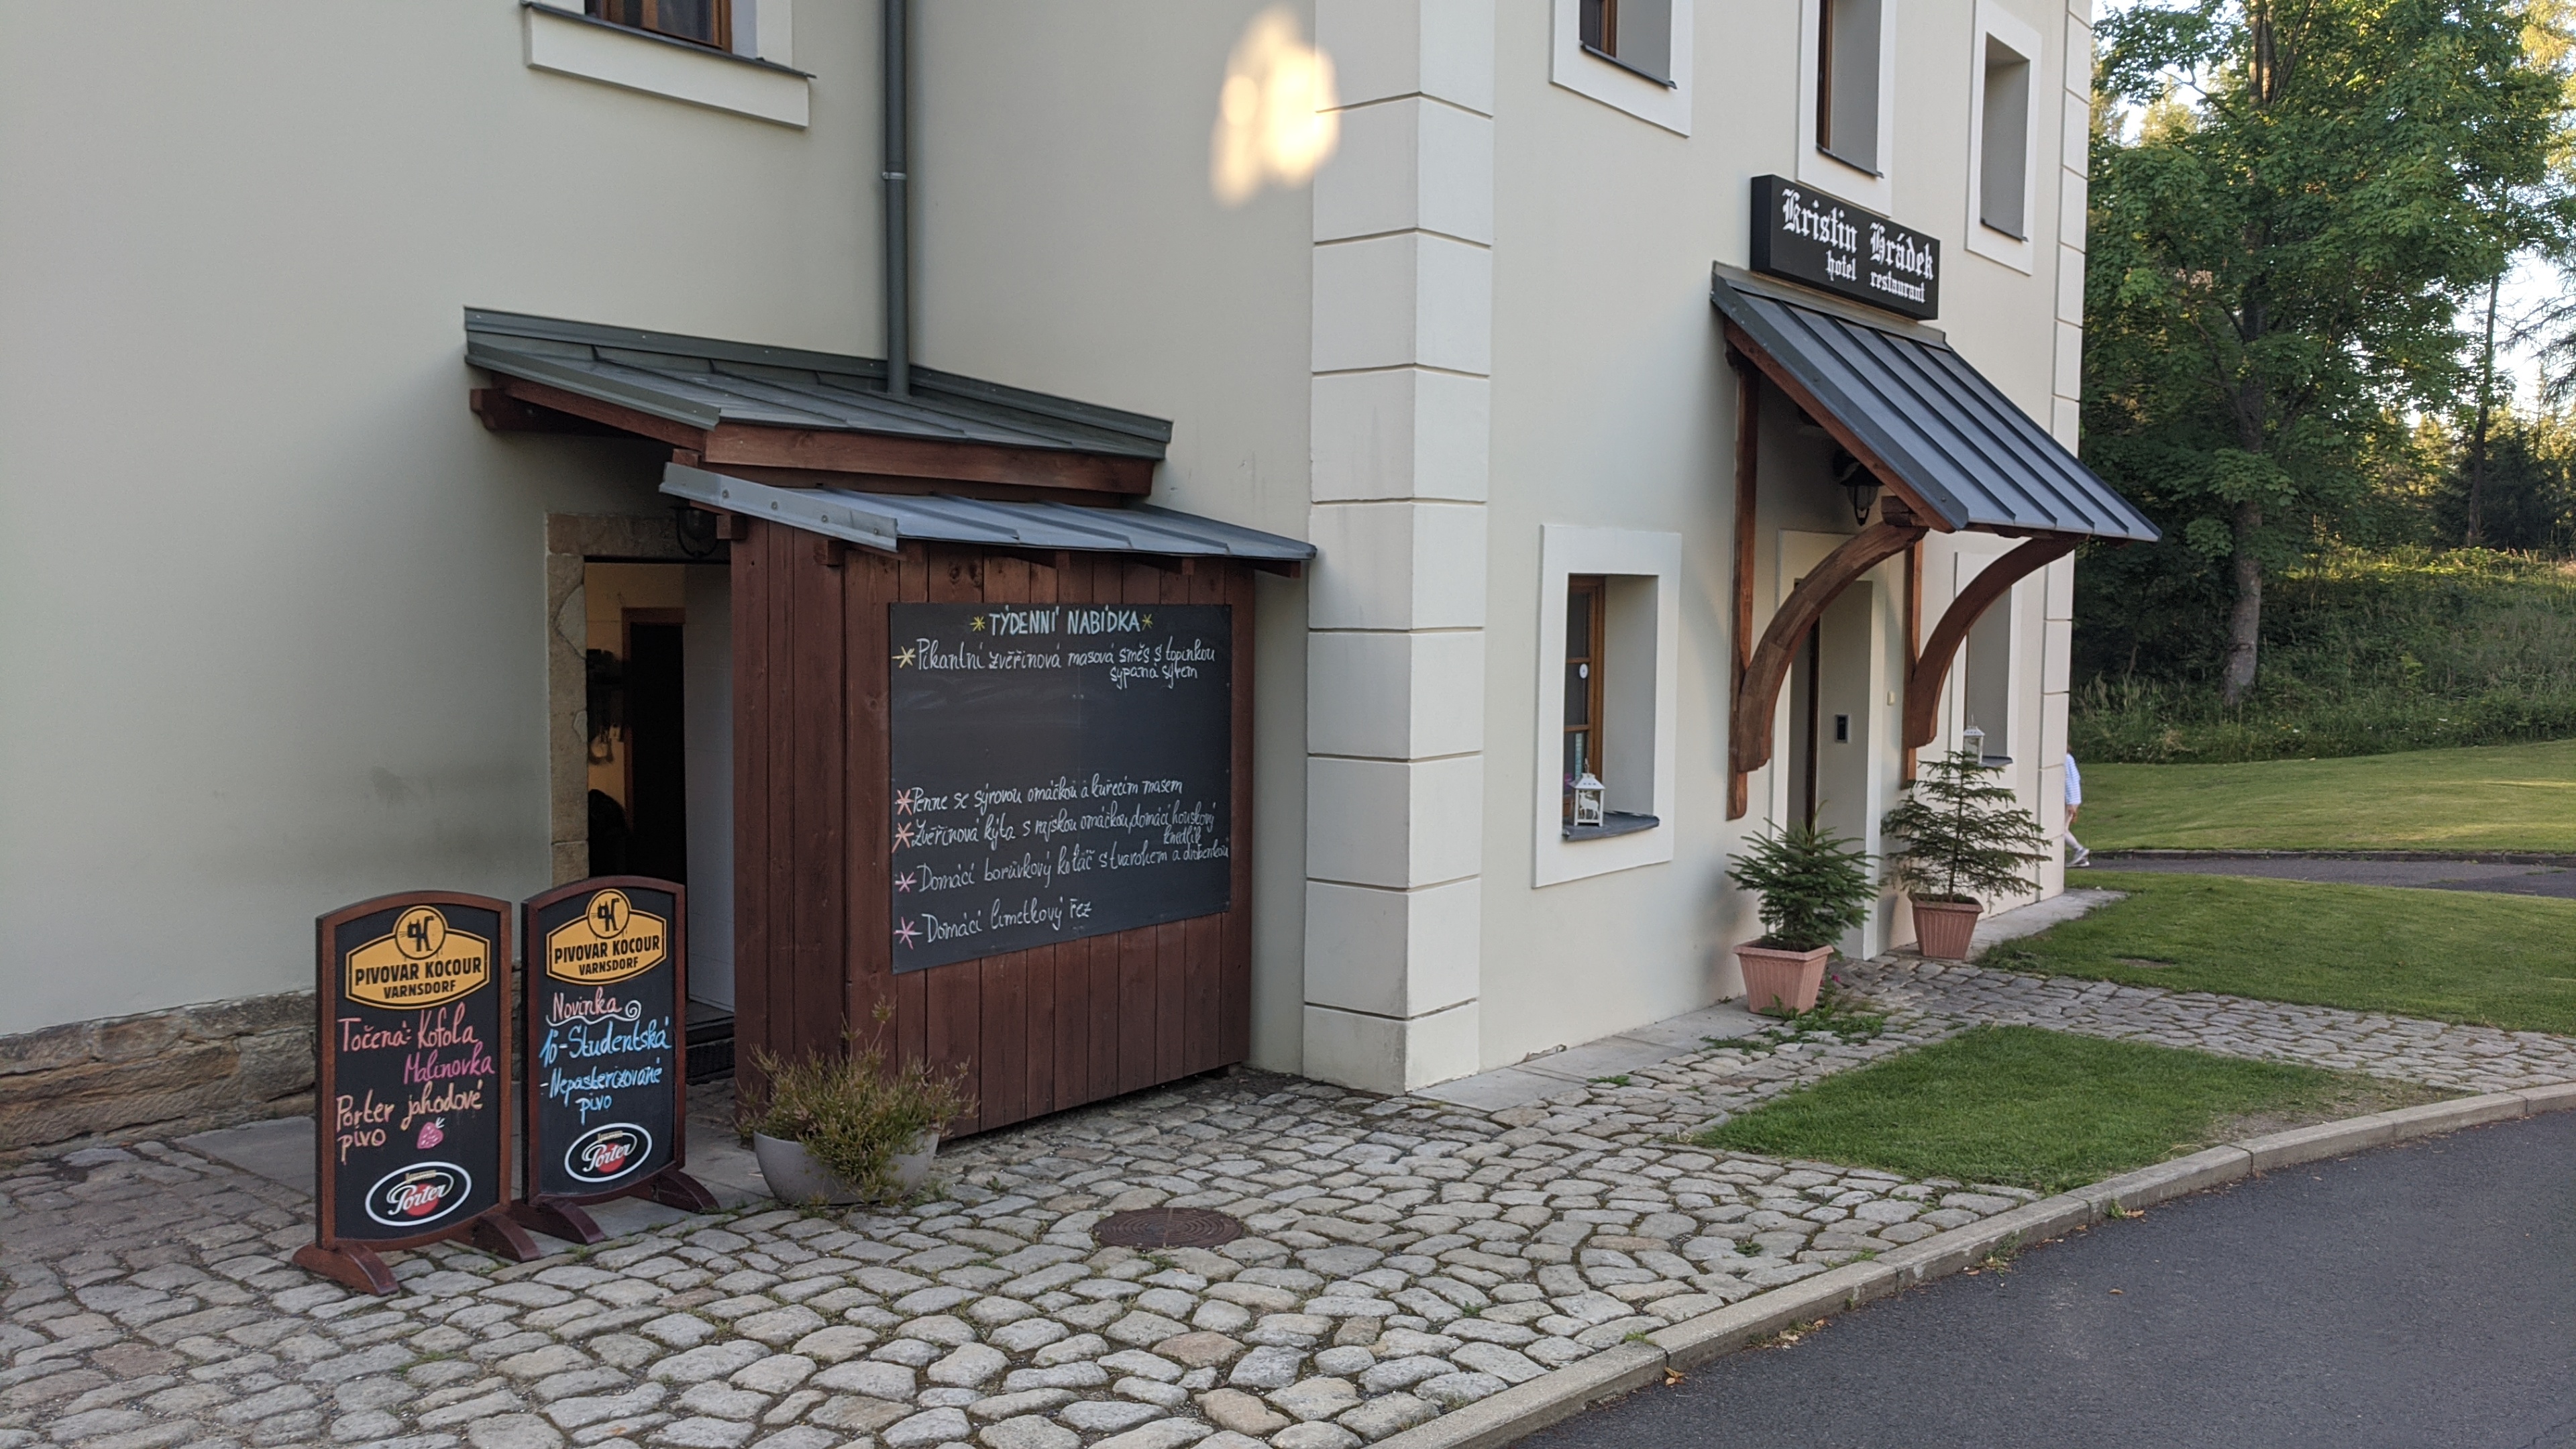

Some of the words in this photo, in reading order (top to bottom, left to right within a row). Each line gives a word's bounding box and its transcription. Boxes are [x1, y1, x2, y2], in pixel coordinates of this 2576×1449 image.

[1782, 189, 1858, 254] Kristin
[1870, 222, 1933, 280] Hrádek
[1825, 250, 1857, 281] hotel
[1870, 270, 1925, 303] restaurant
[989, 606, 1060, 636] TÝDENNÍ
[1067, 604, 1140, 635] NABÍDKA
[916, 637, 985, 670] Pikantní
[989, 642, 1062, 669] zvěřinová
[1067, 643, 1115, 667] masová
[1119, 643, 1150, 663] směs
[1165, 635, 1216, 671] topinkou
[1110, 662, 1159, 690] sypaná
[911, 787, 948, 814] Penne
[953, 792, 969, 810] se
[974, 783, 1022, 816] sýrovou
[1028, 775, 1078, 802] omáčkou
[1091, 773, 1139, 798] kuřecím
[1142, 778, 1183, 795] masem
[911, 818, 979, 847] Zvěřinová
[984, 812, 1016, 851] kýta
[1022, 820, 1031, 837] s
[1034, 808, 1077, 843] rajskou
[1172, 800, 1216, 833] houskový
[1163, 824, 1201, 845] knedlík
[916, 862, 975, 892] Domácí
[984, 851, 1052, 889] borůvkový
[1057, 843, 1096, 875] koláč
[1110, 840, 1168, 870] tvarohem
[1172, 849, 1181, 861] a
[921, 910, 982, 943] Domácí
[990, 896, 1063, 931] limetkový
[1069, 898, 1093, 919] řez
[553, 941, 608, 965] PIVOVAR
[612, 934, 661, 956] KOCOUR
[578, 956, 640, 976] VARNSDORF
[354, 963, 421, 986] PIVOVAR
[425, 957, 482, 979] KOCOUR
[383, 979, 457, 1000] VARNSDORF
[552, 986, 623, 1022] Novinka
[337, 1017, 413, 1052] Točená:
[417, 1002, 480, 1049] Kofola
[404, 1040, 496, 1085] Malinovka
[335, 1089, 395, 1132] Porter
[400, 1079, 484, 1131] jahodové
[575, 1093, 612, 1126] pivo
[336, 1124, 387, 1166] pivo
[581, 1142, 636, 1173] Porter
[386, 1184, 448, 1216] Porter
